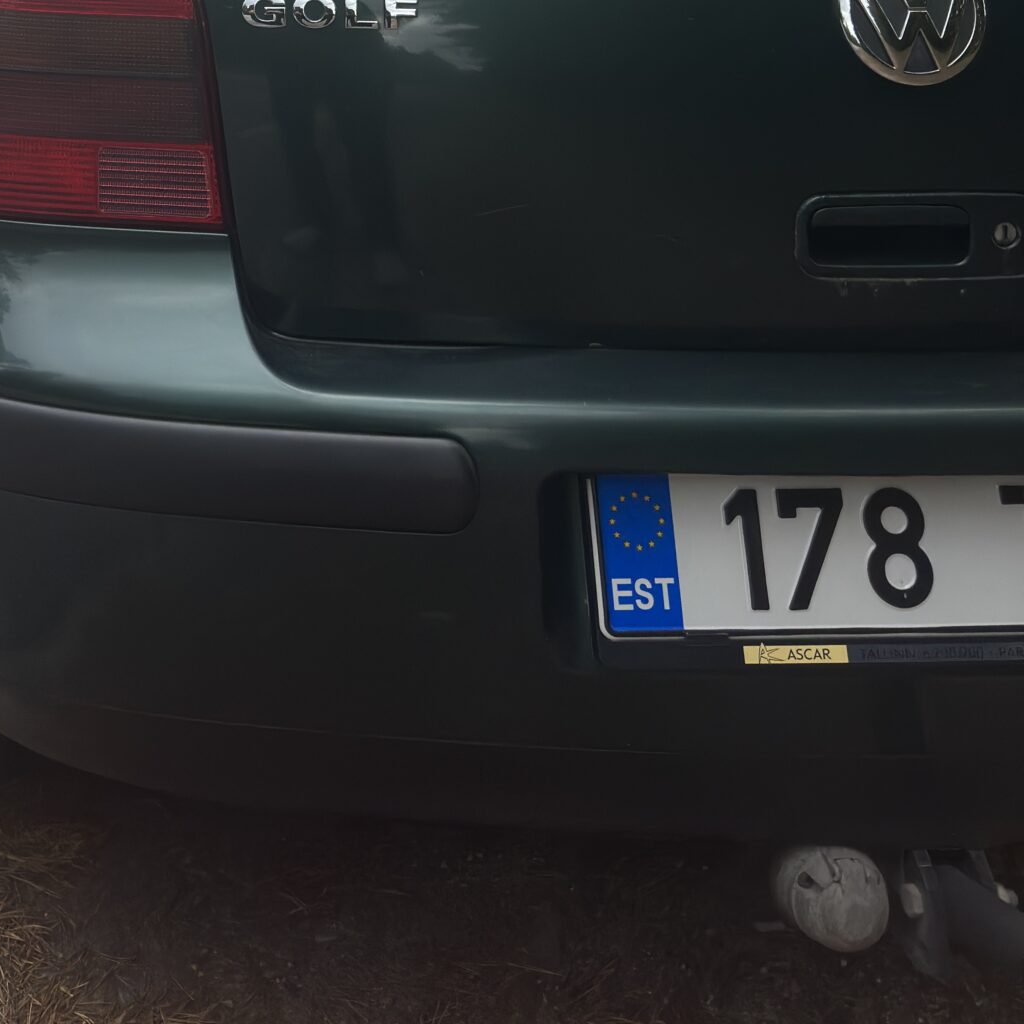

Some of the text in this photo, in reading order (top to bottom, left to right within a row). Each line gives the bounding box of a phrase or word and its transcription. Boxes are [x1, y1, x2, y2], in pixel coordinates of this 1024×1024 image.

[721, 487, 934, 610] 178
[611, 577, 675, 611] EST
[787, 647, 832, 661] ASCAR
